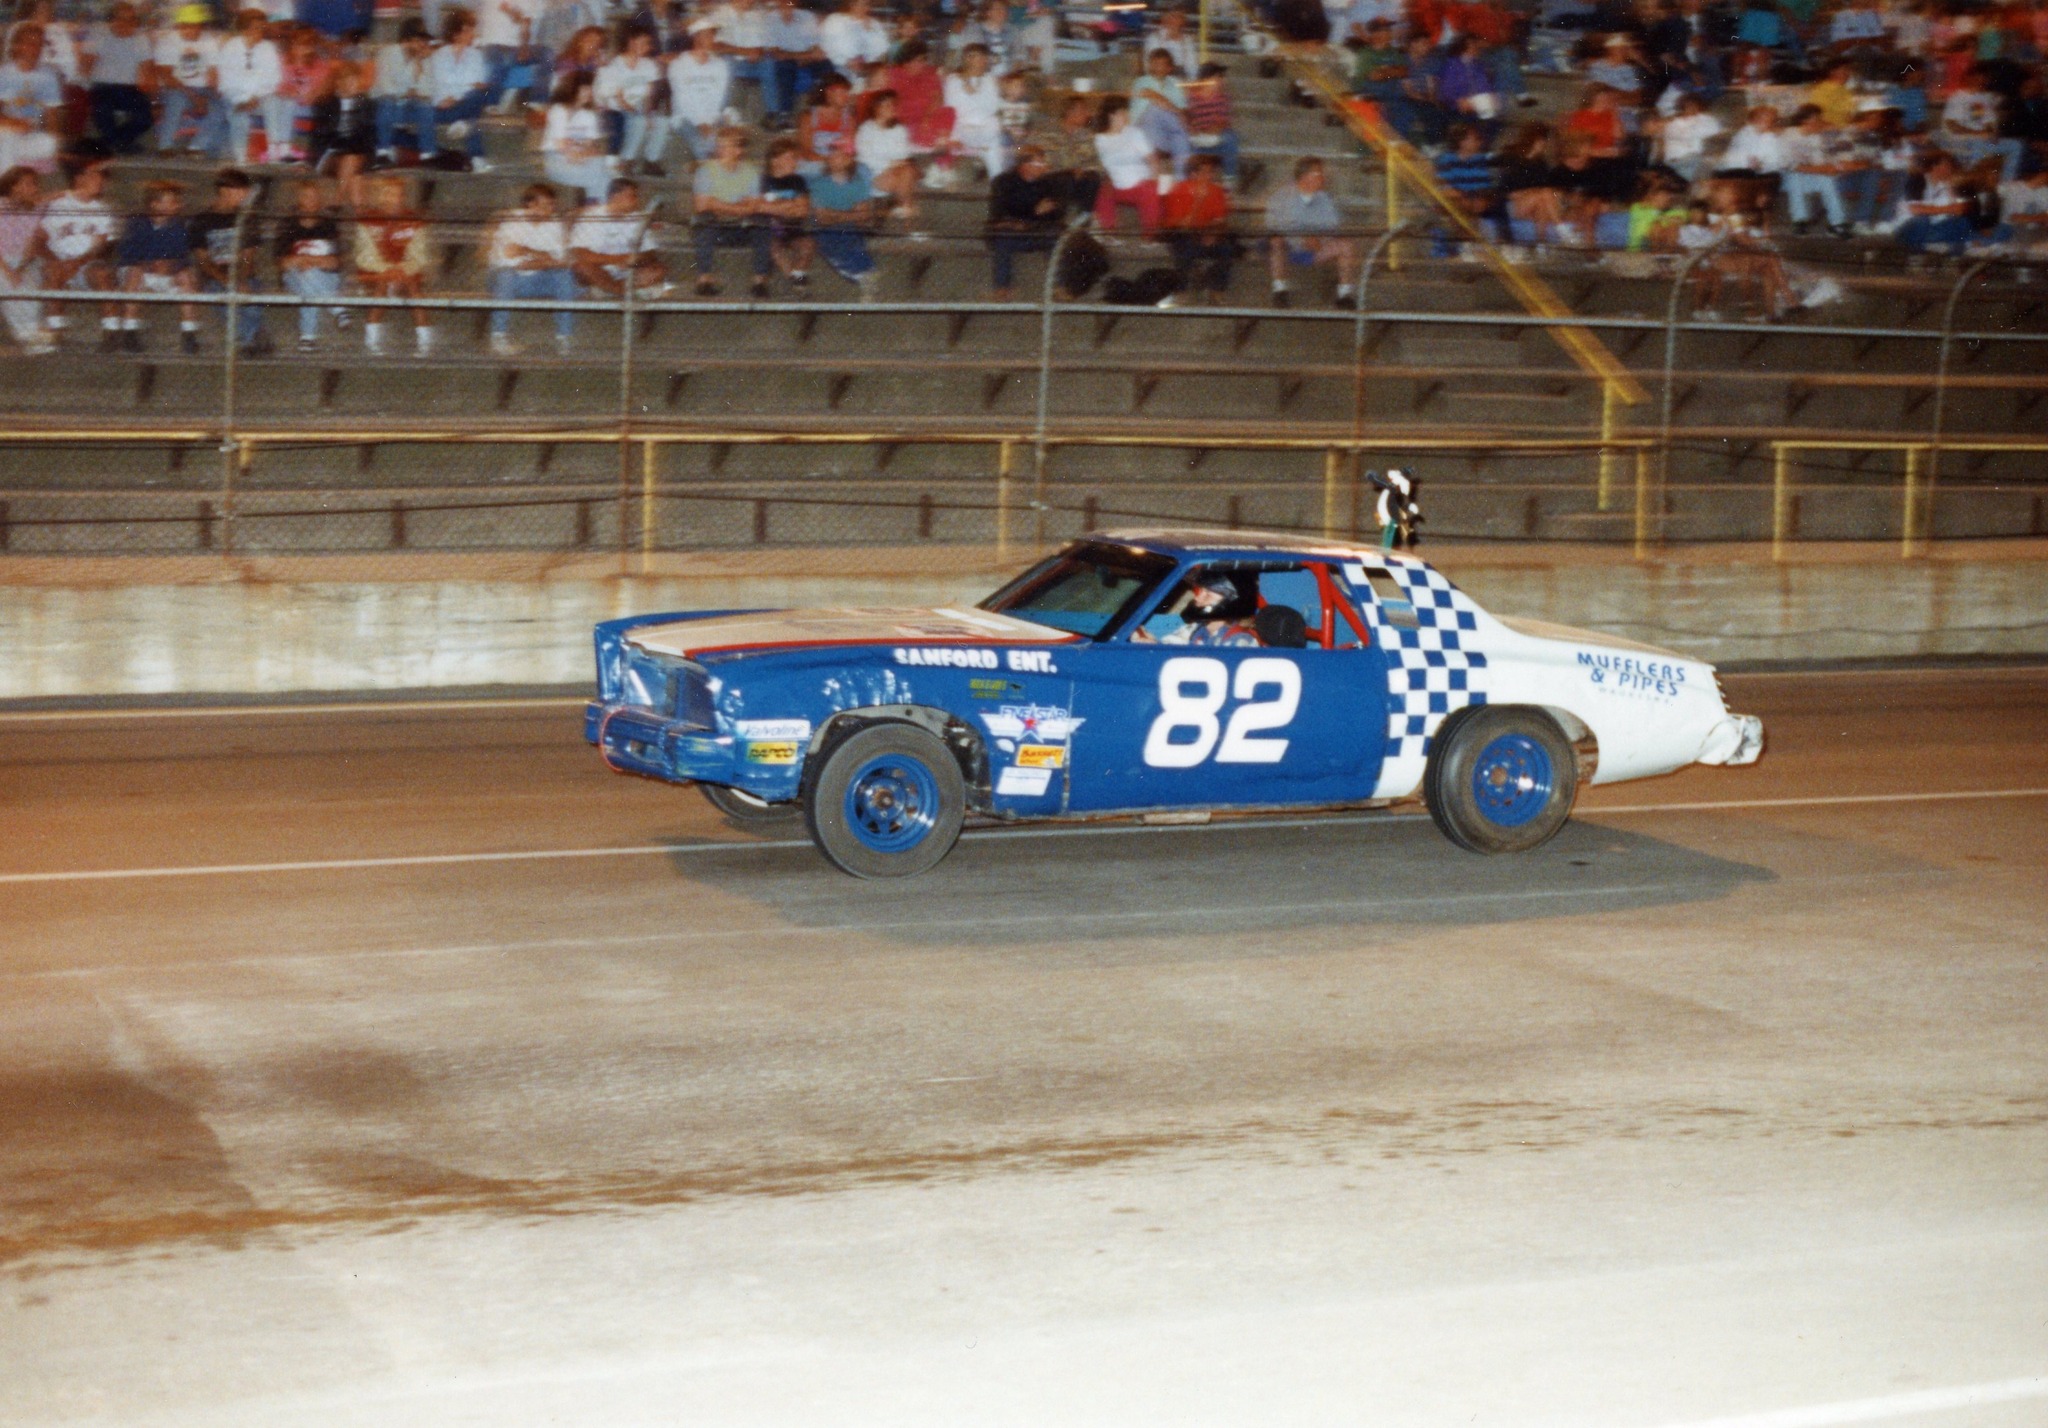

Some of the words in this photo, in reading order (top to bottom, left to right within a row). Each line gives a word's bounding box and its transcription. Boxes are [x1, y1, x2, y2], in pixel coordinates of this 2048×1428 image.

[894, 648, 999, 670] SANFORD
[1007, 650, 1058, 673] ENT.
[1577, 652, 1686, 682] MUFFLERS
[1590, 667, 1605, 683] &
[1619, 672, 1678, 697] PIPES
[1143, 656, 1302, 768] 82
